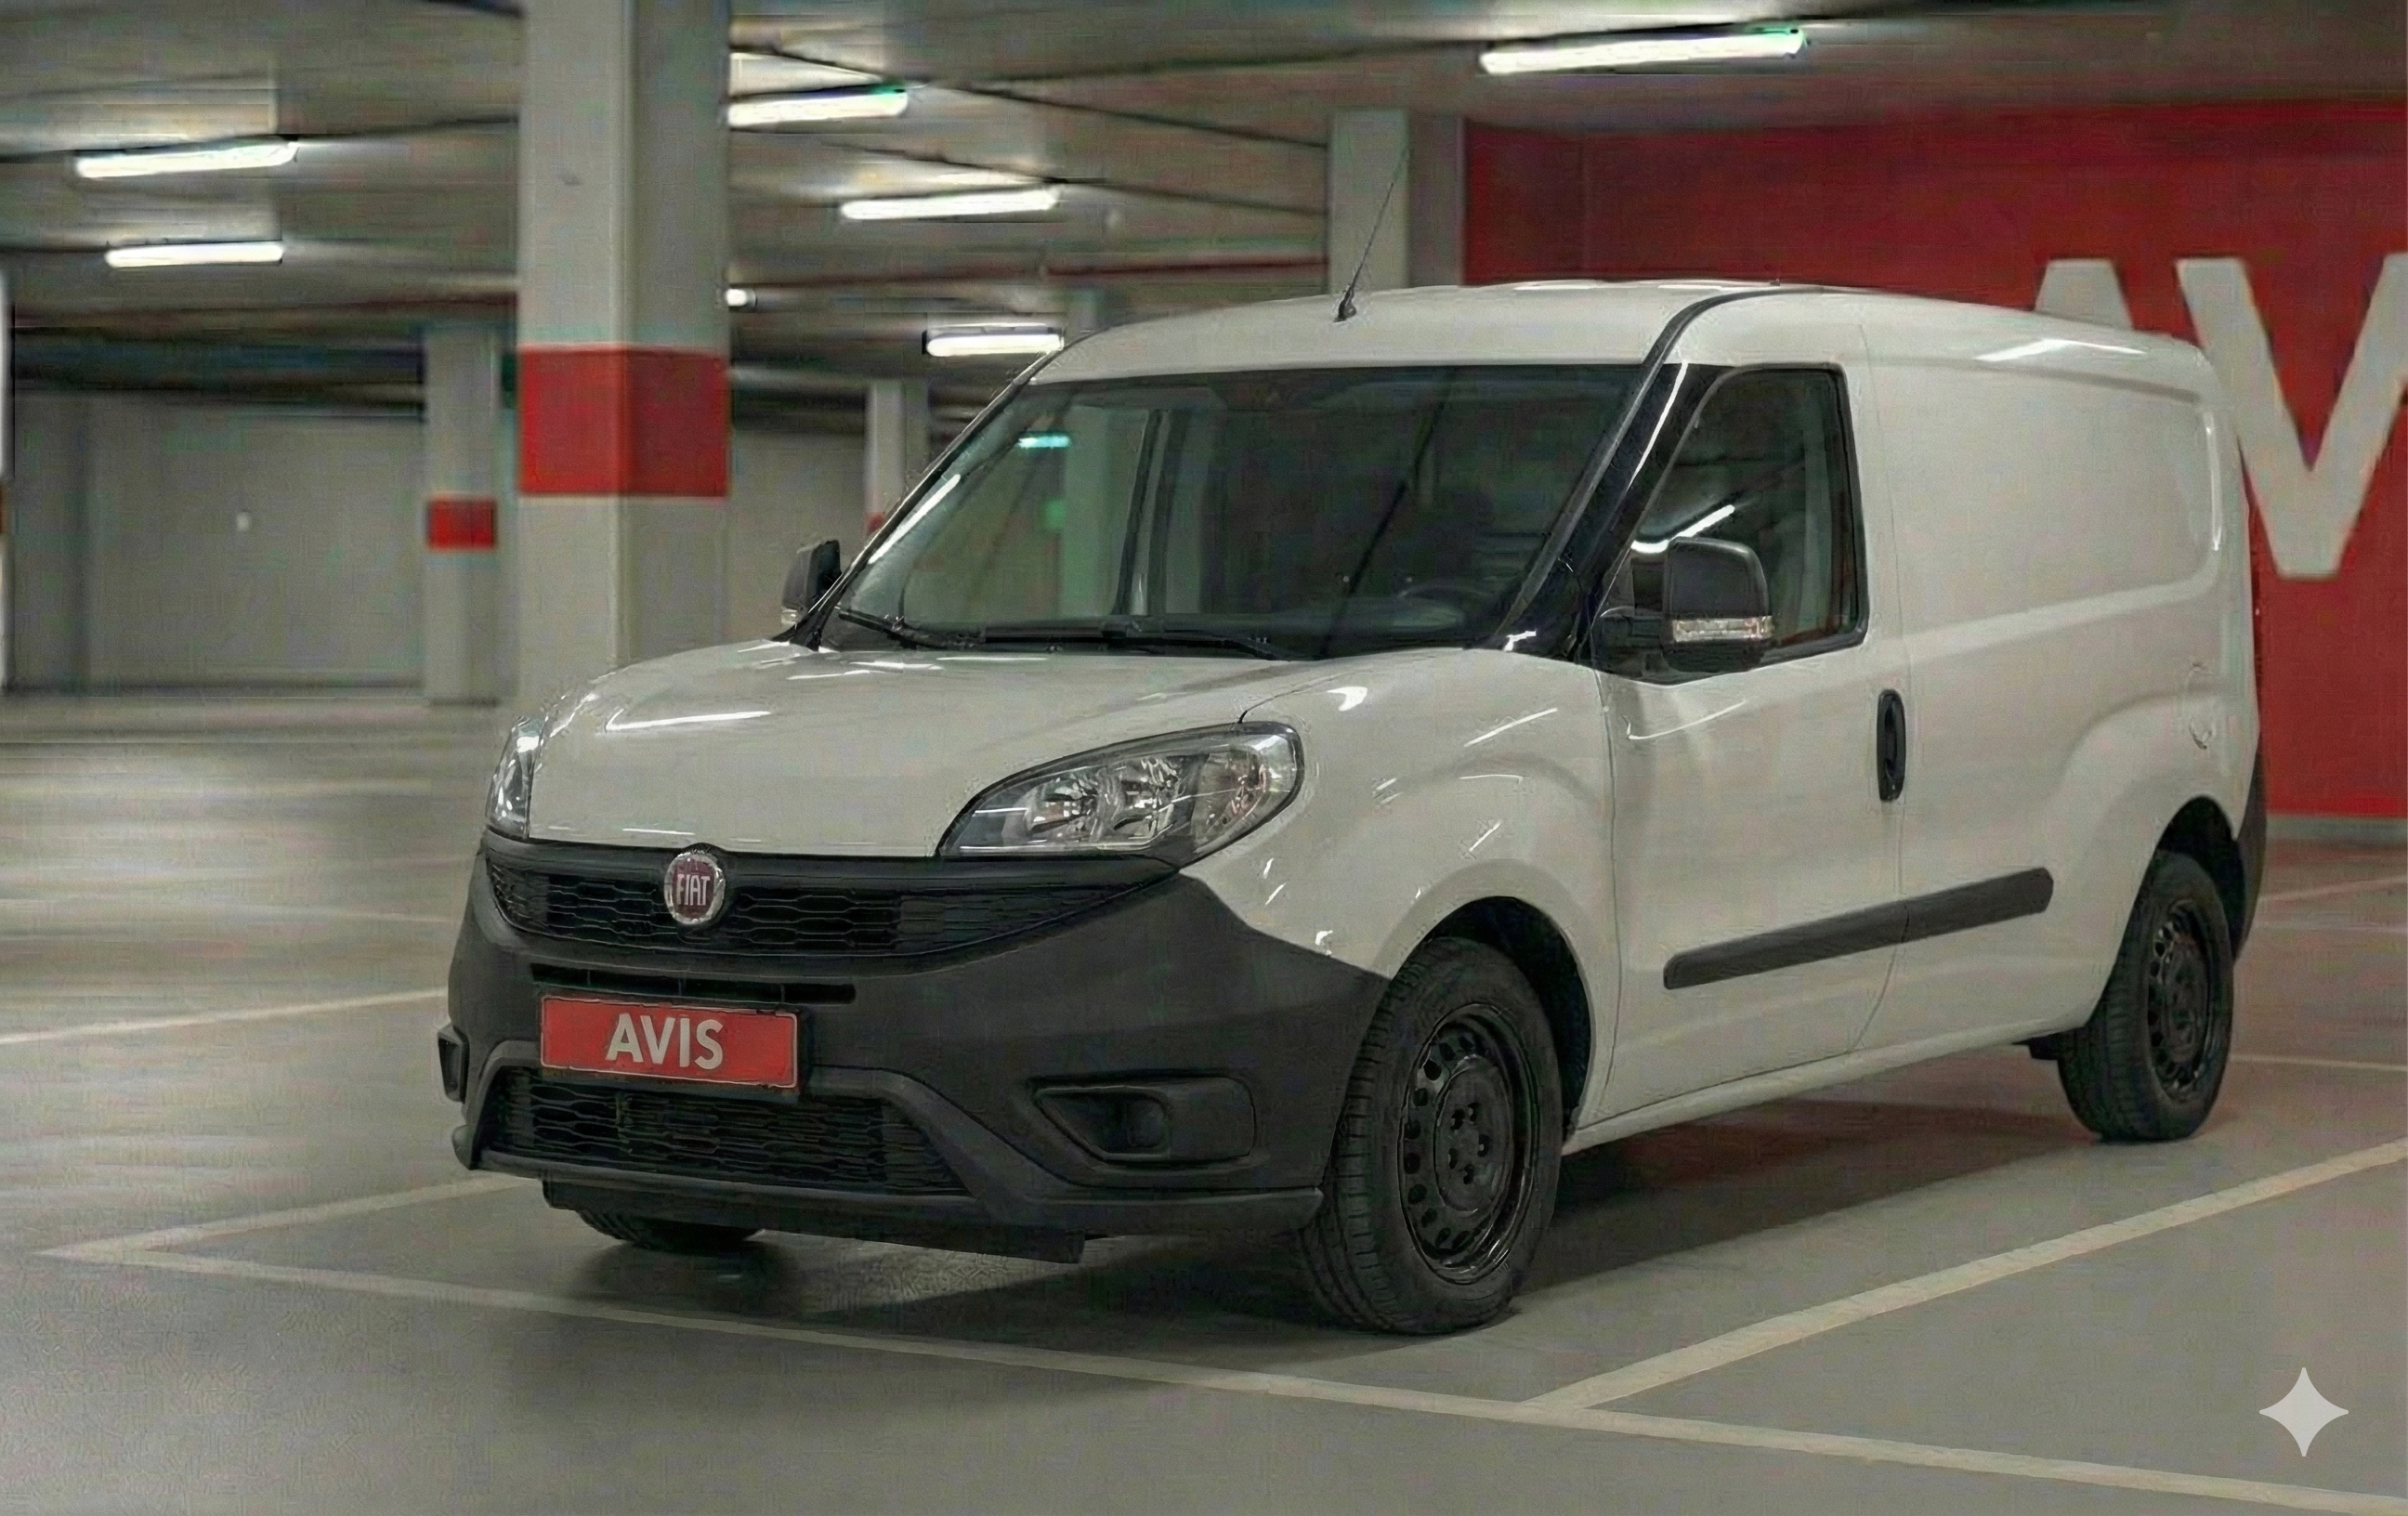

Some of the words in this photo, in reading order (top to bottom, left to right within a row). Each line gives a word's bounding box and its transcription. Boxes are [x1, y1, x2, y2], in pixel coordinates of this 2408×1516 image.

[2035, 252, 2408, 579] V
[675, 873, 711, 907] FIAT
[606, 1013, 724, 1069] AVIS
